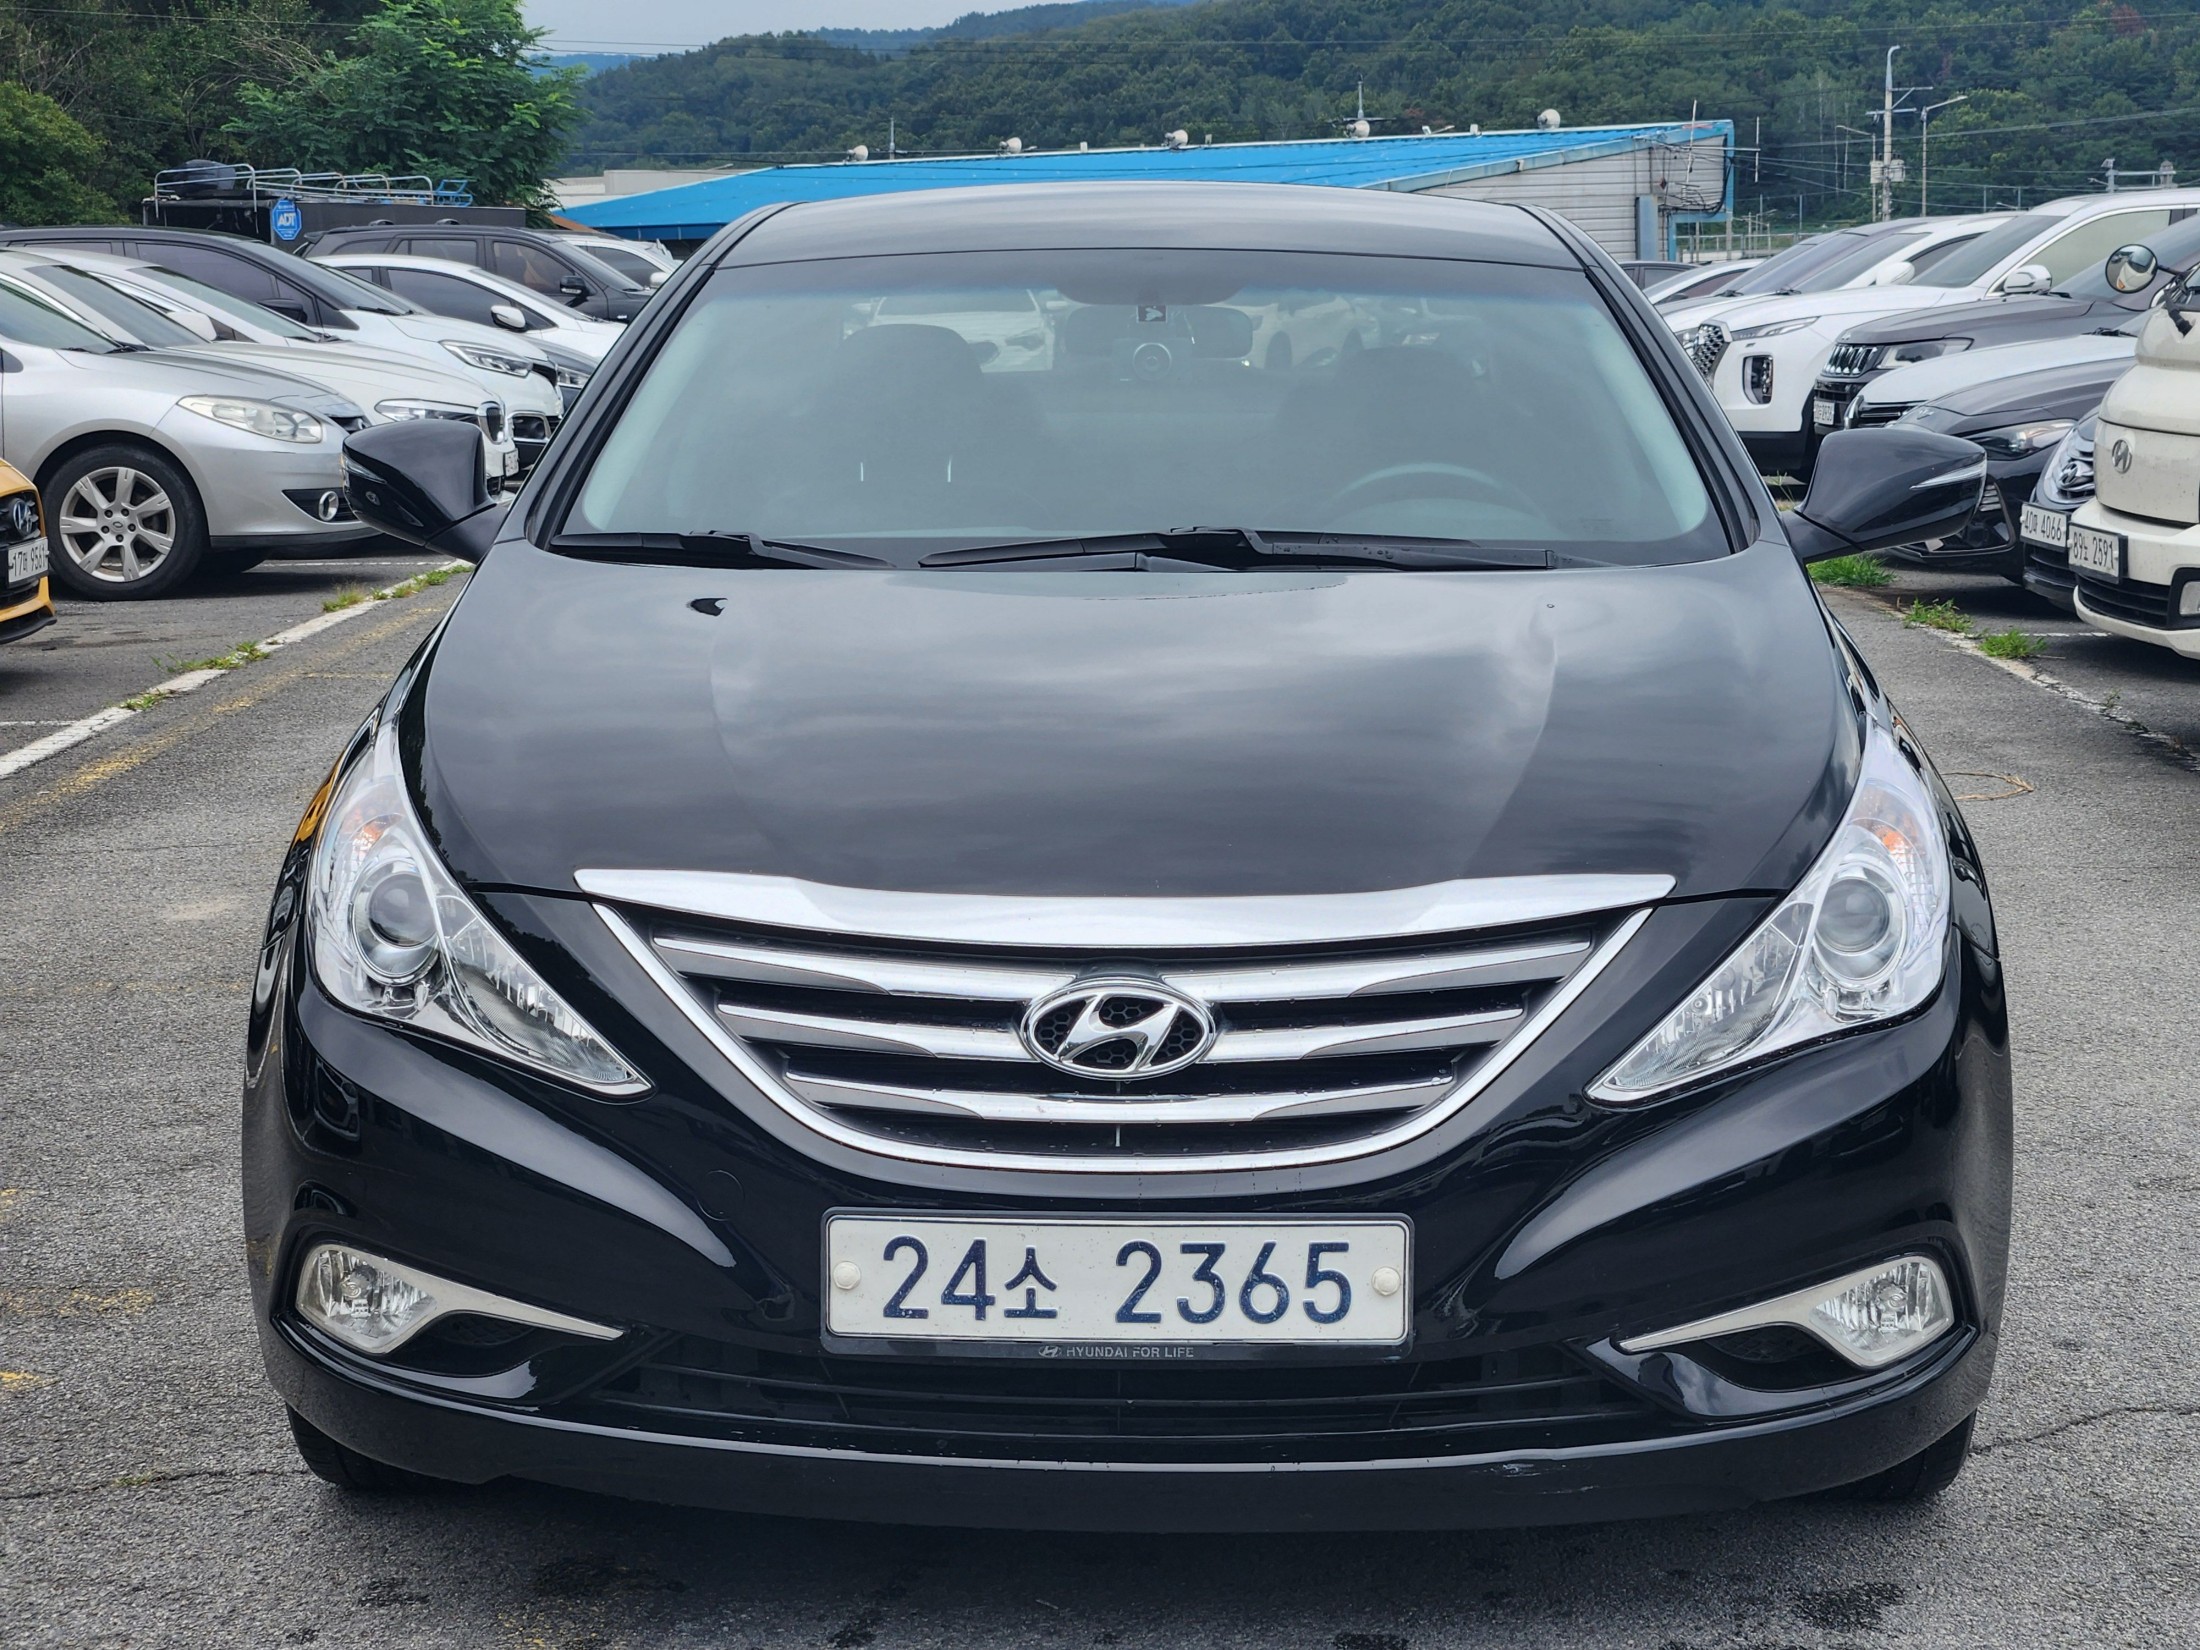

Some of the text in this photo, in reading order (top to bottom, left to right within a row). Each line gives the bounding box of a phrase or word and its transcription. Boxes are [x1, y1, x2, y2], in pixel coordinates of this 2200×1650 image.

[277, 212, 297, 227] ADT
[2041, 514, 2062, 541] 4066
[2092, 536, 2115, 570] 2591
[882, 1235, 1352, 1324] 24소 2365
[1066, 1346, 1195, 1358] HYUNDAI FOR LIFE
